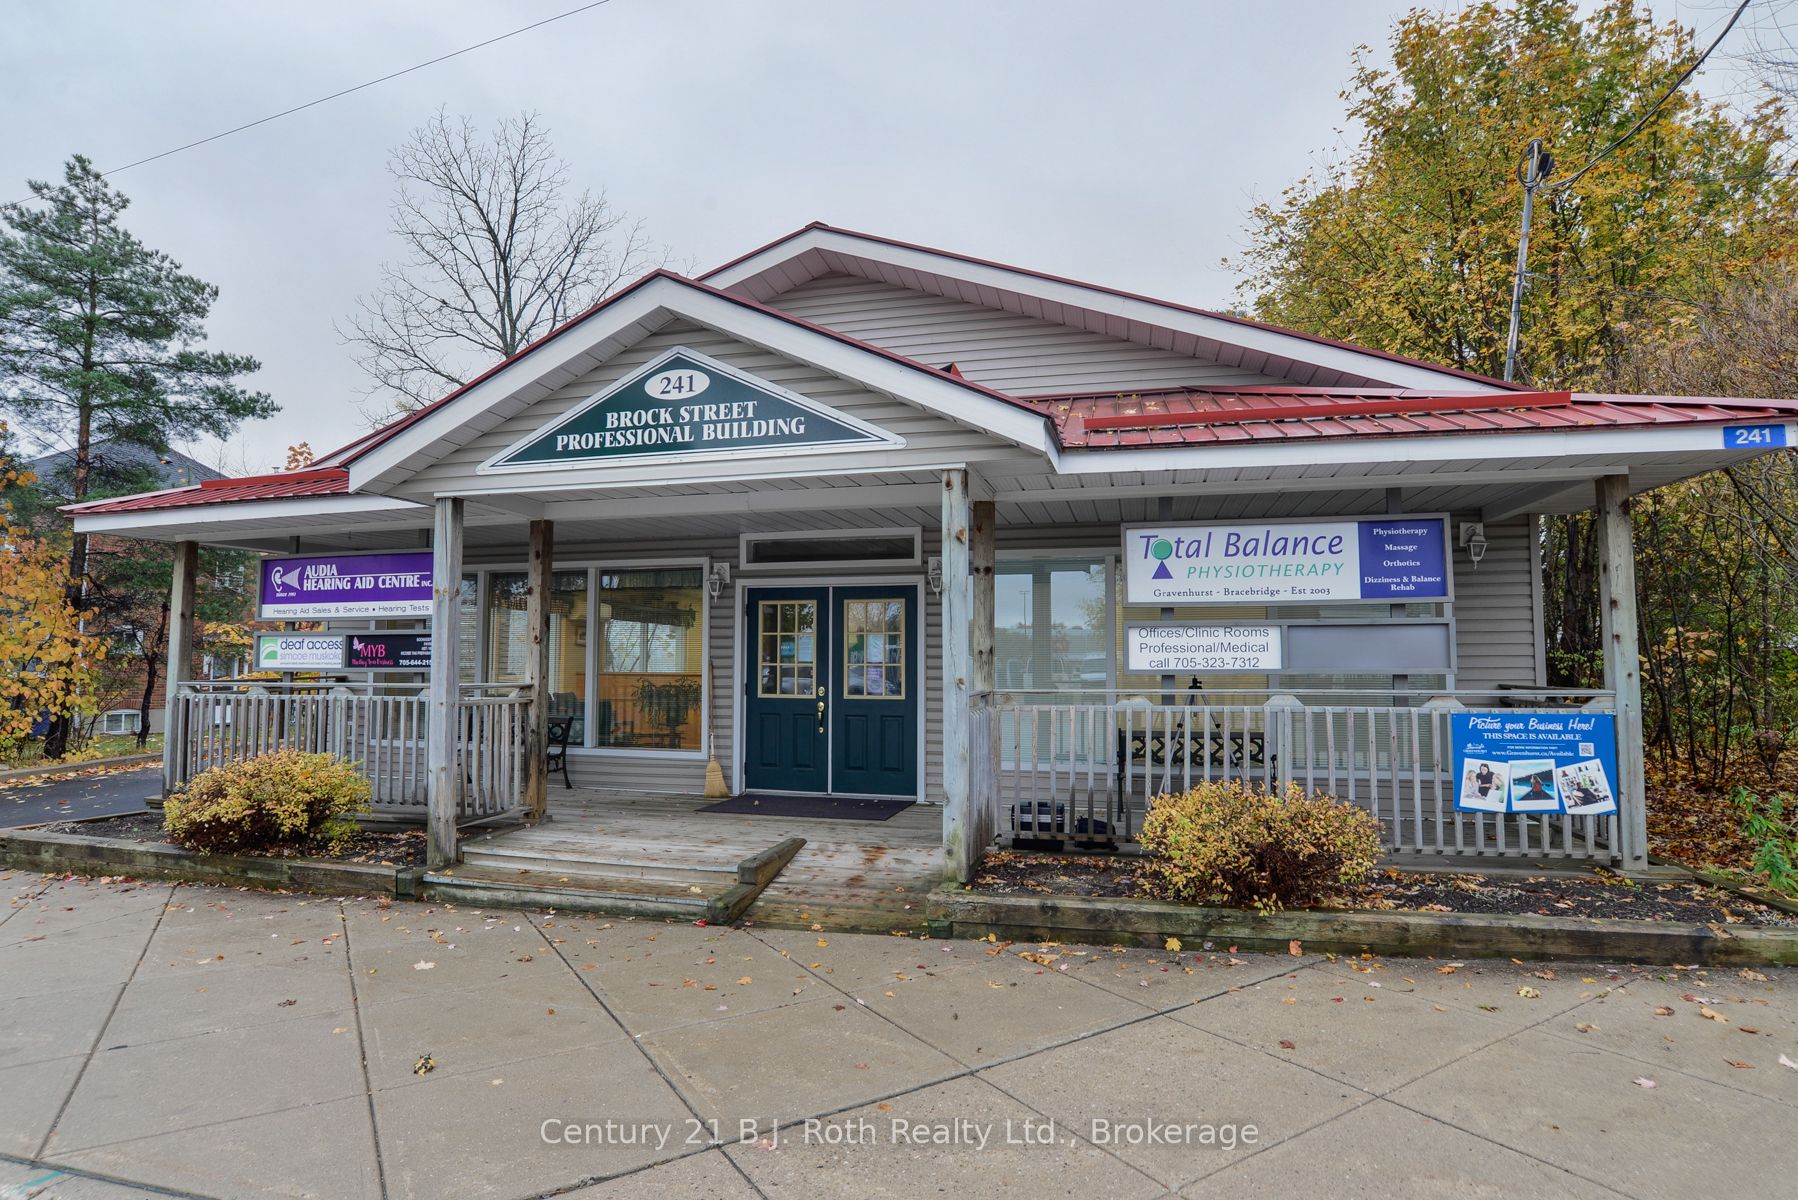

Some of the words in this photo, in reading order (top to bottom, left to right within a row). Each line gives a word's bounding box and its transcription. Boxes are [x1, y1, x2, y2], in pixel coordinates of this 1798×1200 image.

[659, 374, 696, 395] 241
[606, 408, 673, 429] BROCK
[679, 401, 757, 423] STREET
[556, 424, 694, 451] PROFESSIONAL
[702, 417, 805, 441] BUILDING
[1735, 428, 1771, 444] 241
[1373, 528, 1428, 536] Physiotherapy
[1140, 531, 1212, 560] Total
[1224, 529, 1344, 558] Balance
[1384, 544, 1418, 552] Massage
[304, 564, 338, 578] AUDIA
[1187, 563, 1344, 579] PHYSIOTHERAPY
[303, 577, 351, 591] HEARING
[354, 576, 374, 589] AID
[378, 574, 420, 588] CENTRE
[1154, 588, 1213, 597] Gravenhurst
[1224, 587, 1280, 598] Bracebridge
[1291, 586, 1306, 594] Est
[1310, 587, 1331, 596] 2003
[273, 607, 298, 616] Hearing
[378, 604, 406, 613] Hearing
[1138, 626, 1220, 639] Offices/Clinic
[1224, 626, 1270, 638] Rooms
[280, 638, 304, 650] deaf
[307, 640, 342, 650] access
[360, 644, 386, 657] MYB
[1140, 642, 1269, 654] Professional/Medical
[280, 652, 308, 660] simcoe
[1150, 657, 1170, 668] call
[1174, 656, 1260, 668] 705-323-7312
[1469, 716, 1502, 730] Picture
[1504, 722, 1525, 732] your
[1528, 717, 1564, 730] Business
[1568, 717, 1595, 731] Here!
